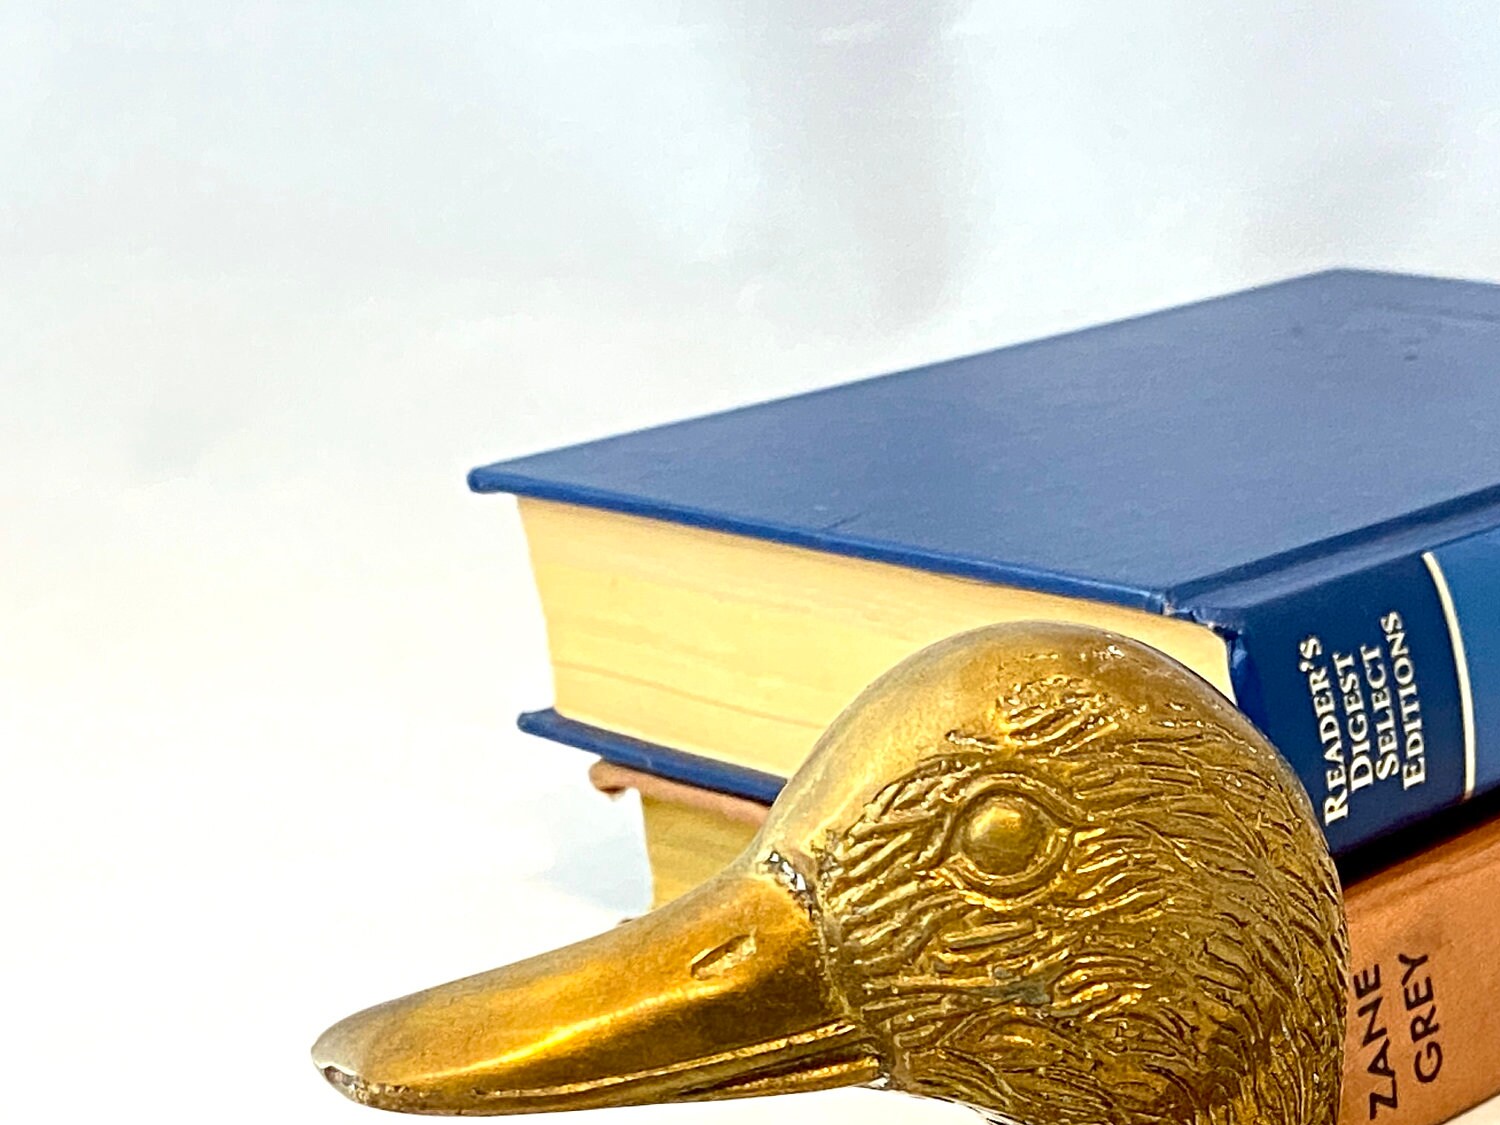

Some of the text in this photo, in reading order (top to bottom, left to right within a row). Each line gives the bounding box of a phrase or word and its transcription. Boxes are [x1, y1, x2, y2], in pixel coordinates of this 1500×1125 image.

[1300, 635, 1349, 825] READER'S
[1333, 652, 1373, 793] DIGEST
[1361, 644, 1400, 781] SELECT
[1380, 610, 1426, 790] EDITIONS
[1353, 963, 1398, 1120] ZANE
[1398, 952, 1443, 1084] GREY
